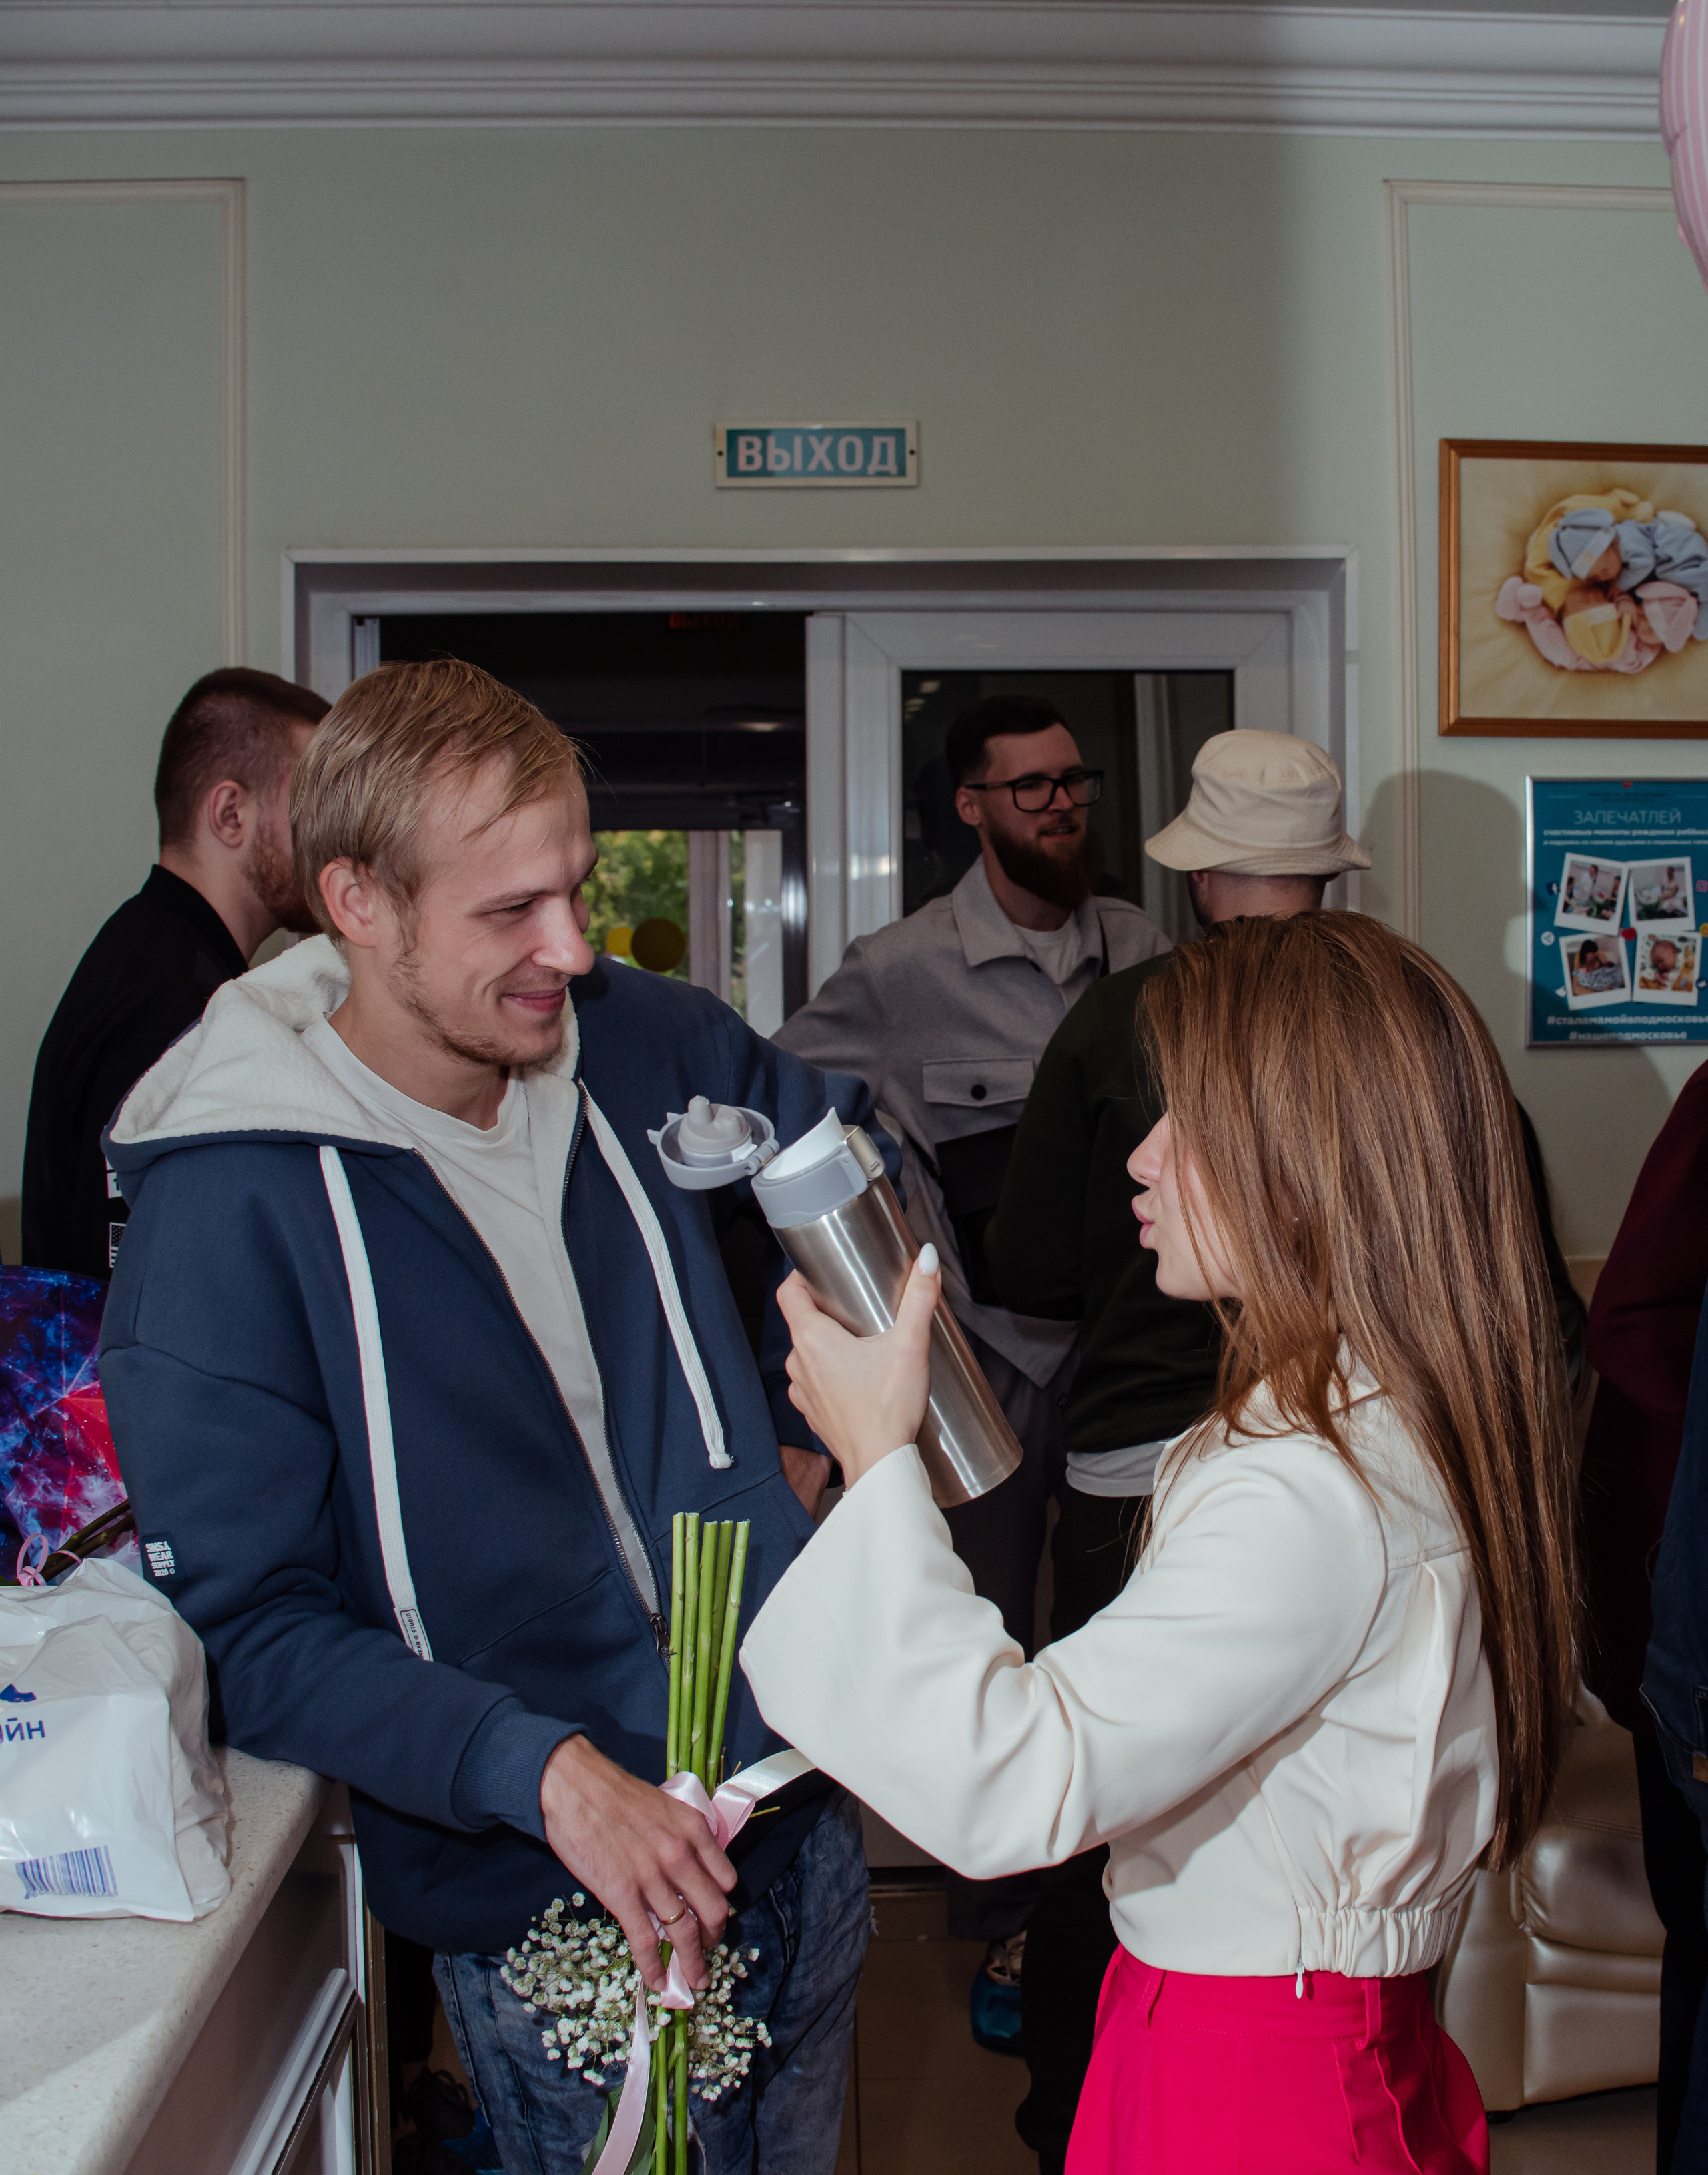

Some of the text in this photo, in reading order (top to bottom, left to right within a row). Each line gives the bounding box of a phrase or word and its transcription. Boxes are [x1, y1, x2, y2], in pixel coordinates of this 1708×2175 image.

[737, 436, 899, 475] ВЫХОД
[1574, 808, 1681, 824] ЗАПЕЧАТЛЕЙ
[148, 1550, 174, 1562] WEAR
[151, 1559, 175, 1569] SUPPLY
[153, 1568, 169, 1576] 2020
[406, 1612, 417, 1633] STUDIO
